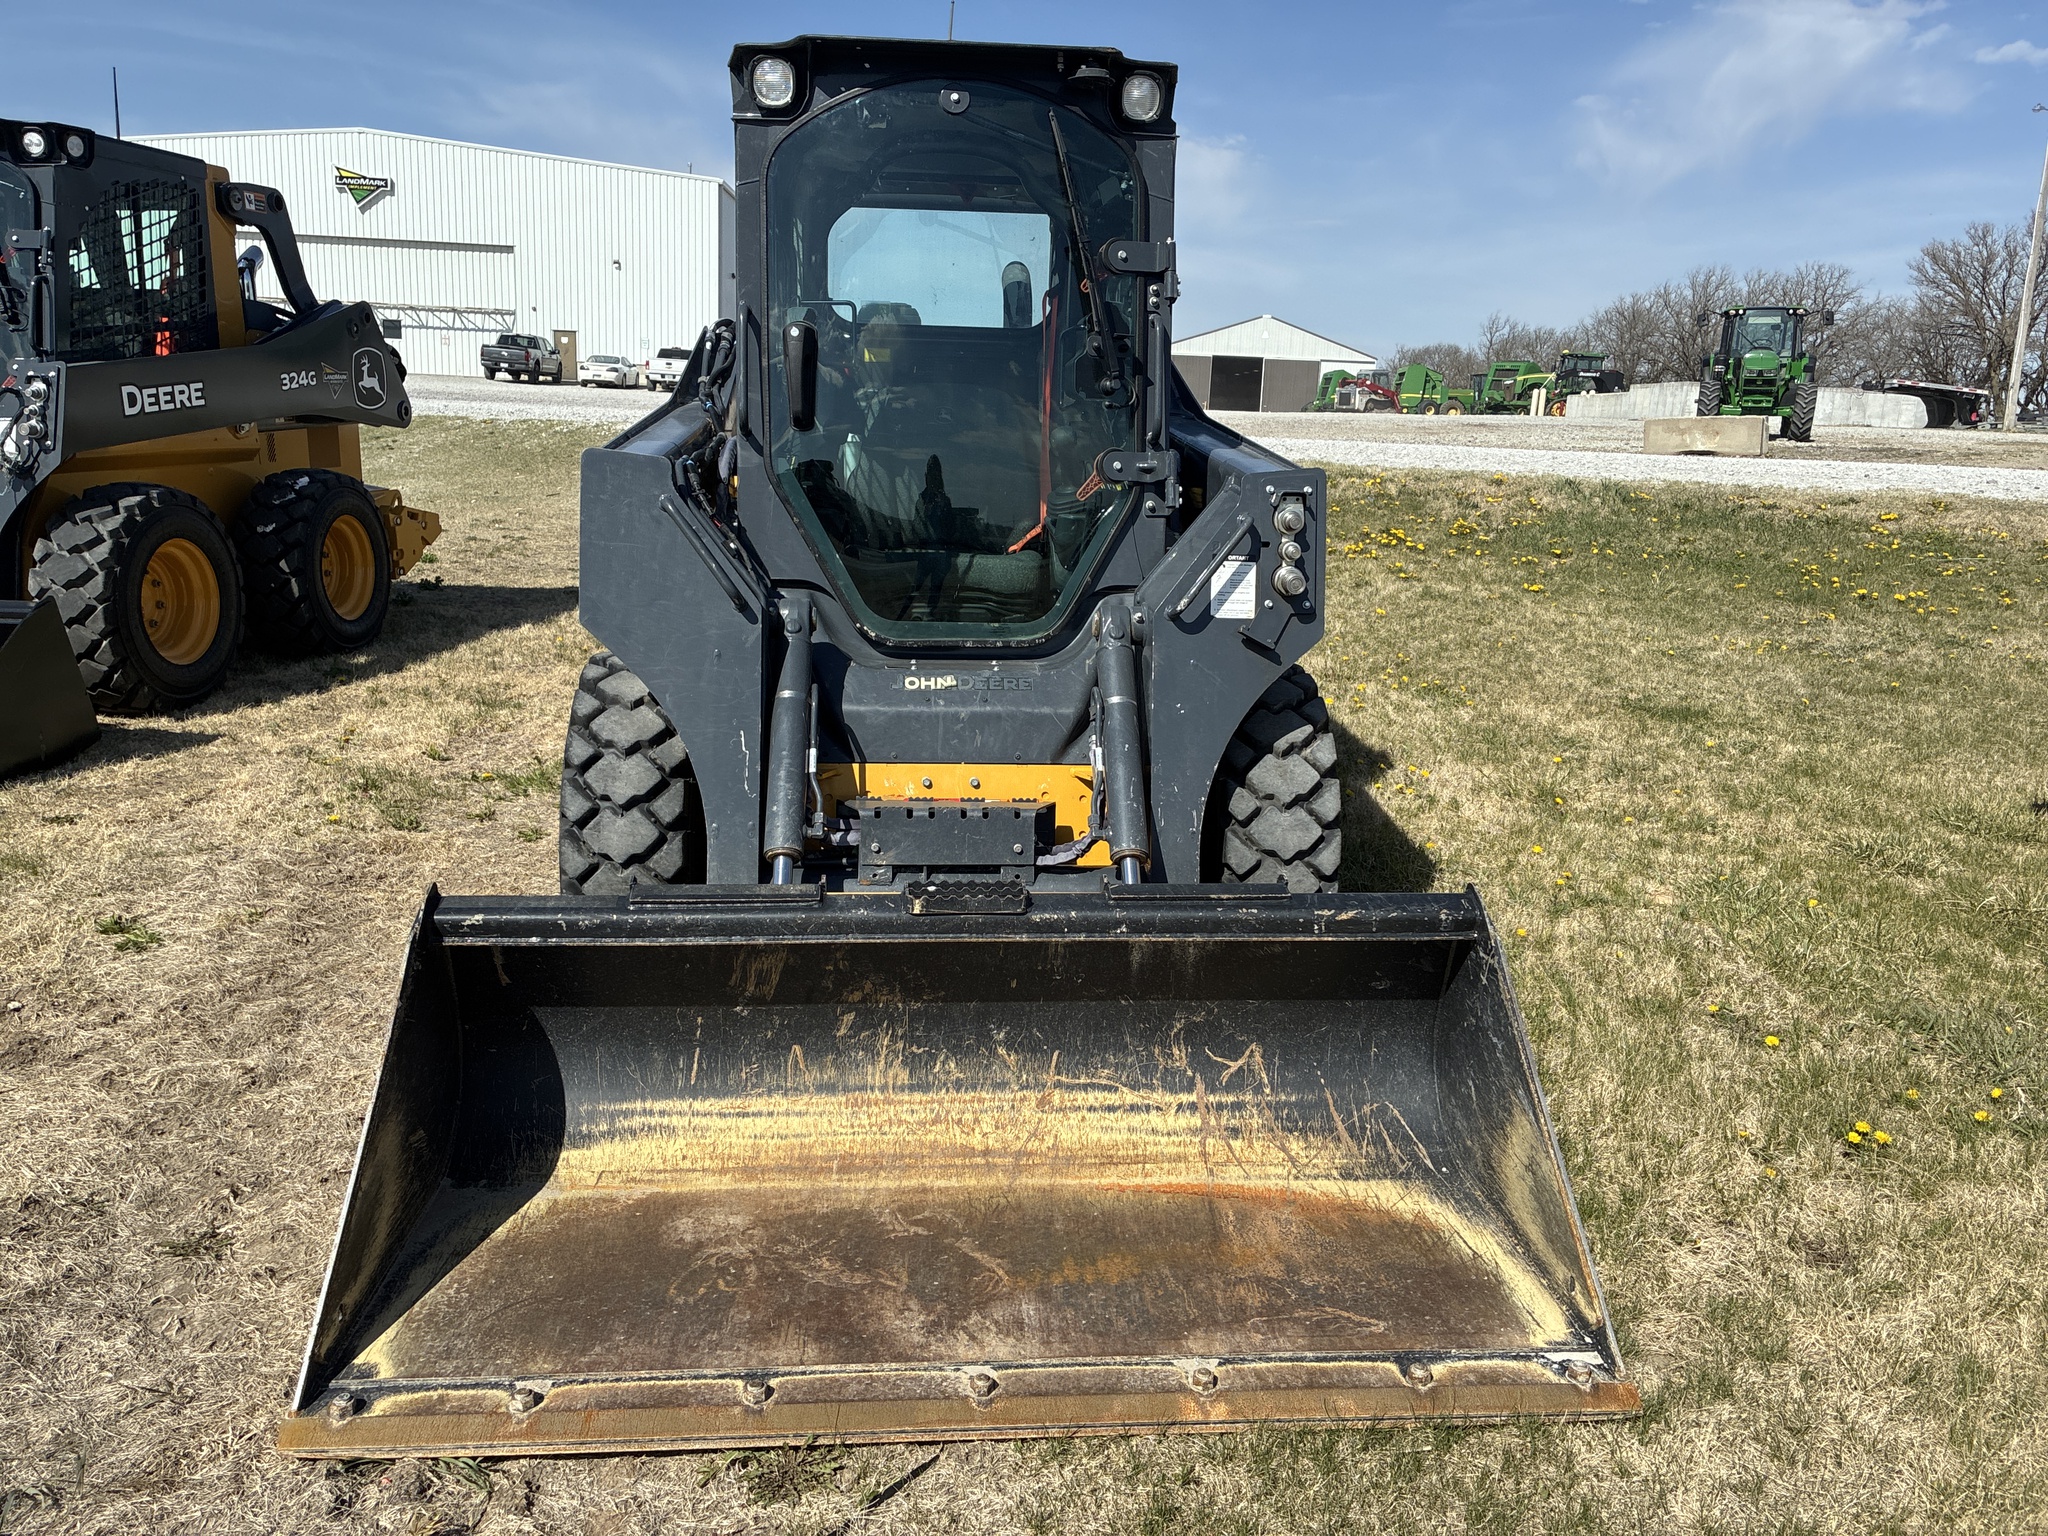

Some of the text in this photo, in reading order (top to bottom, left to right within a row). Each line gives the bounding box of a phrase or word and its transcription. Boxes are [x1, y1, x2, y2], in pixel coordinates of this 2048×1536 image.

[336, 176, 387, 187] LANDMARK
[280, 370, 317, 391] 324G
[120, 381, 206, 416] DEERE
[957, 675, 1034, 690] DEERE
